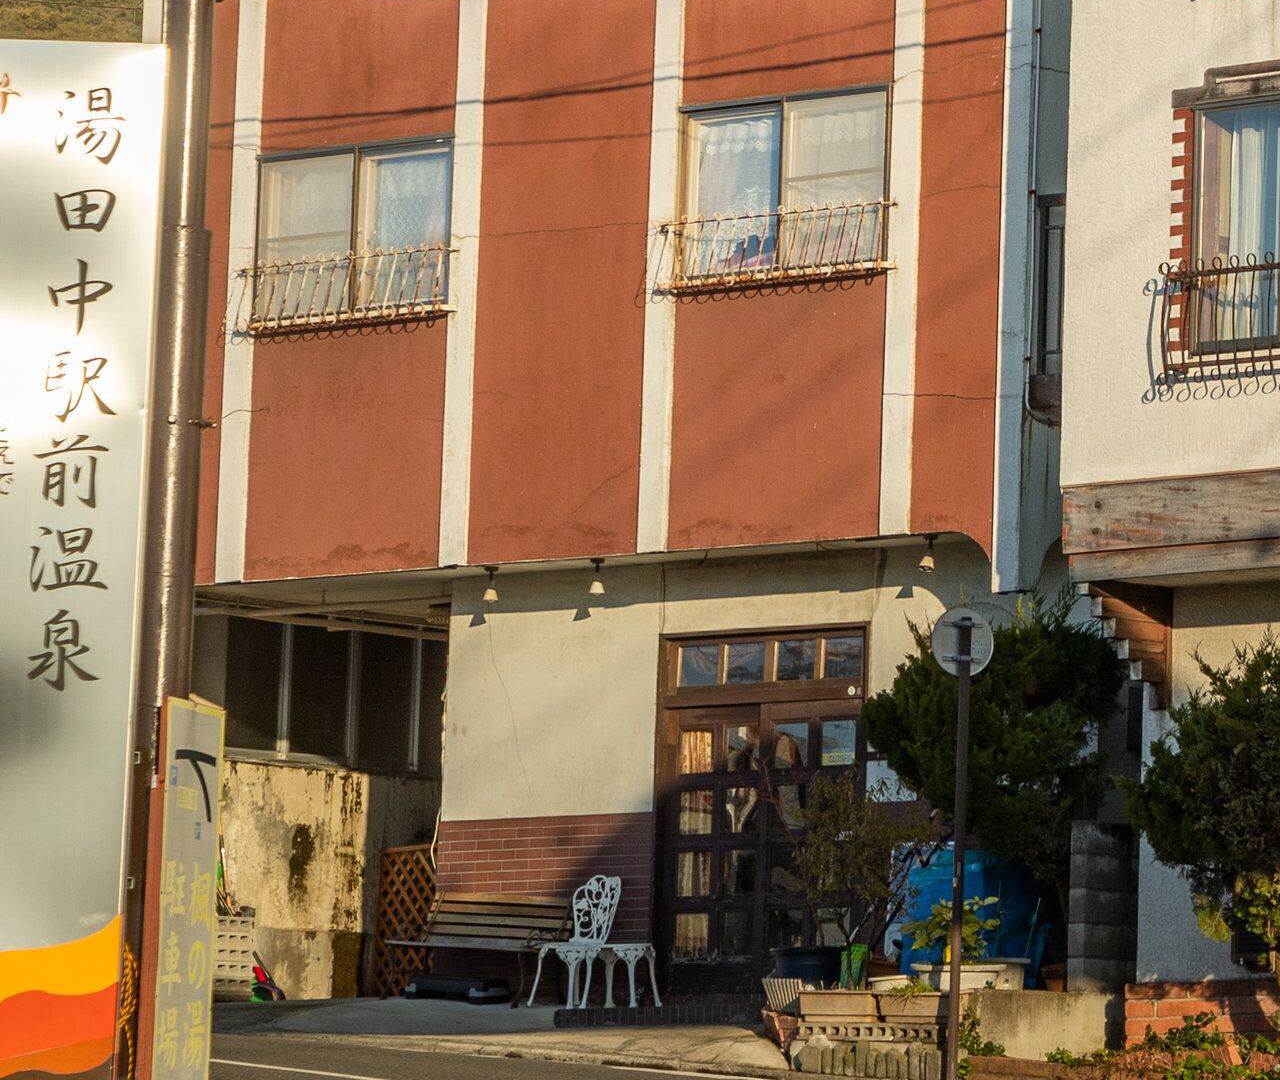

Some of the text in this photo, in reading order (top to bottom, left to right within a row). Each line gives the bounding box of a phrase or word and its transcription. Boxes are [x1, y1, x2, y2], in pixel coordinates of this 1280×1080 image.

[27, 87, 127, 692] 湯田中駅前温泉
[155, 859, 187, 1070] 駐車場
